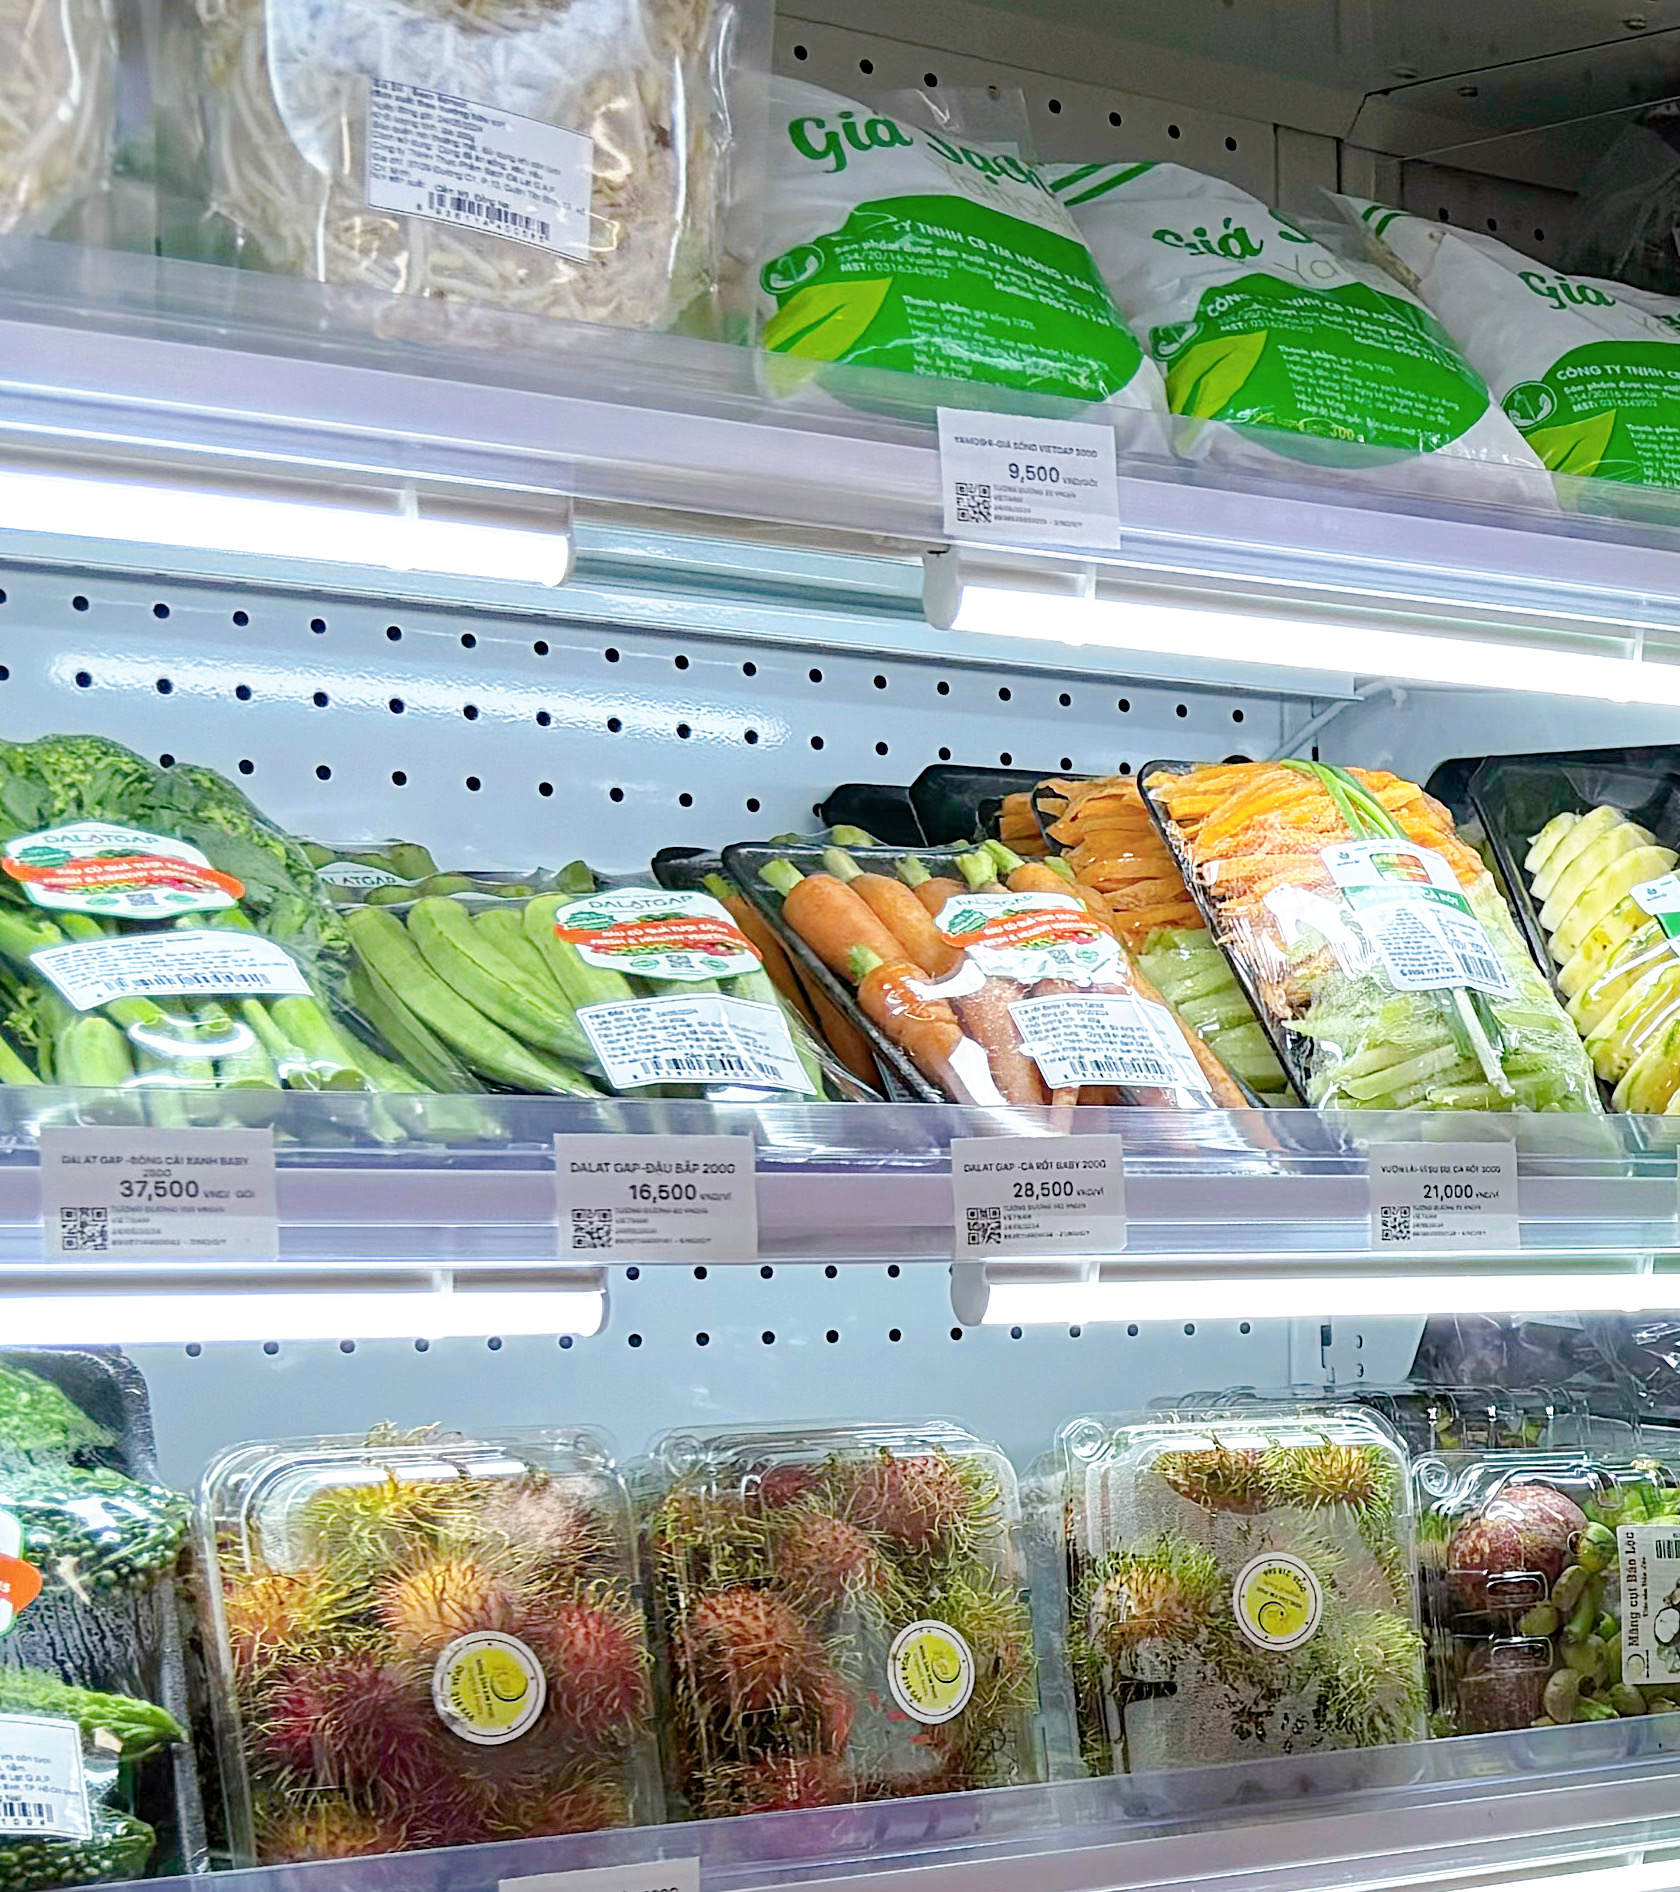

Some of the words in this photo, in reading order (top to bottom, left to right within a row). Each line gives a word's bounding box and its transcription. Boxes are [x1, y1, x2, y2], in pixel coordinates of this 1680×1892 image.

[1008, 462, 1060, 484] 9,500
[119, 1180, 199, 1201] 37,500
[628, 1183, 697, 1203] 16,500
[1013, 1181, 1074, 1200] 28,500
[1423, 1184, 1473, 1202] 21,000
